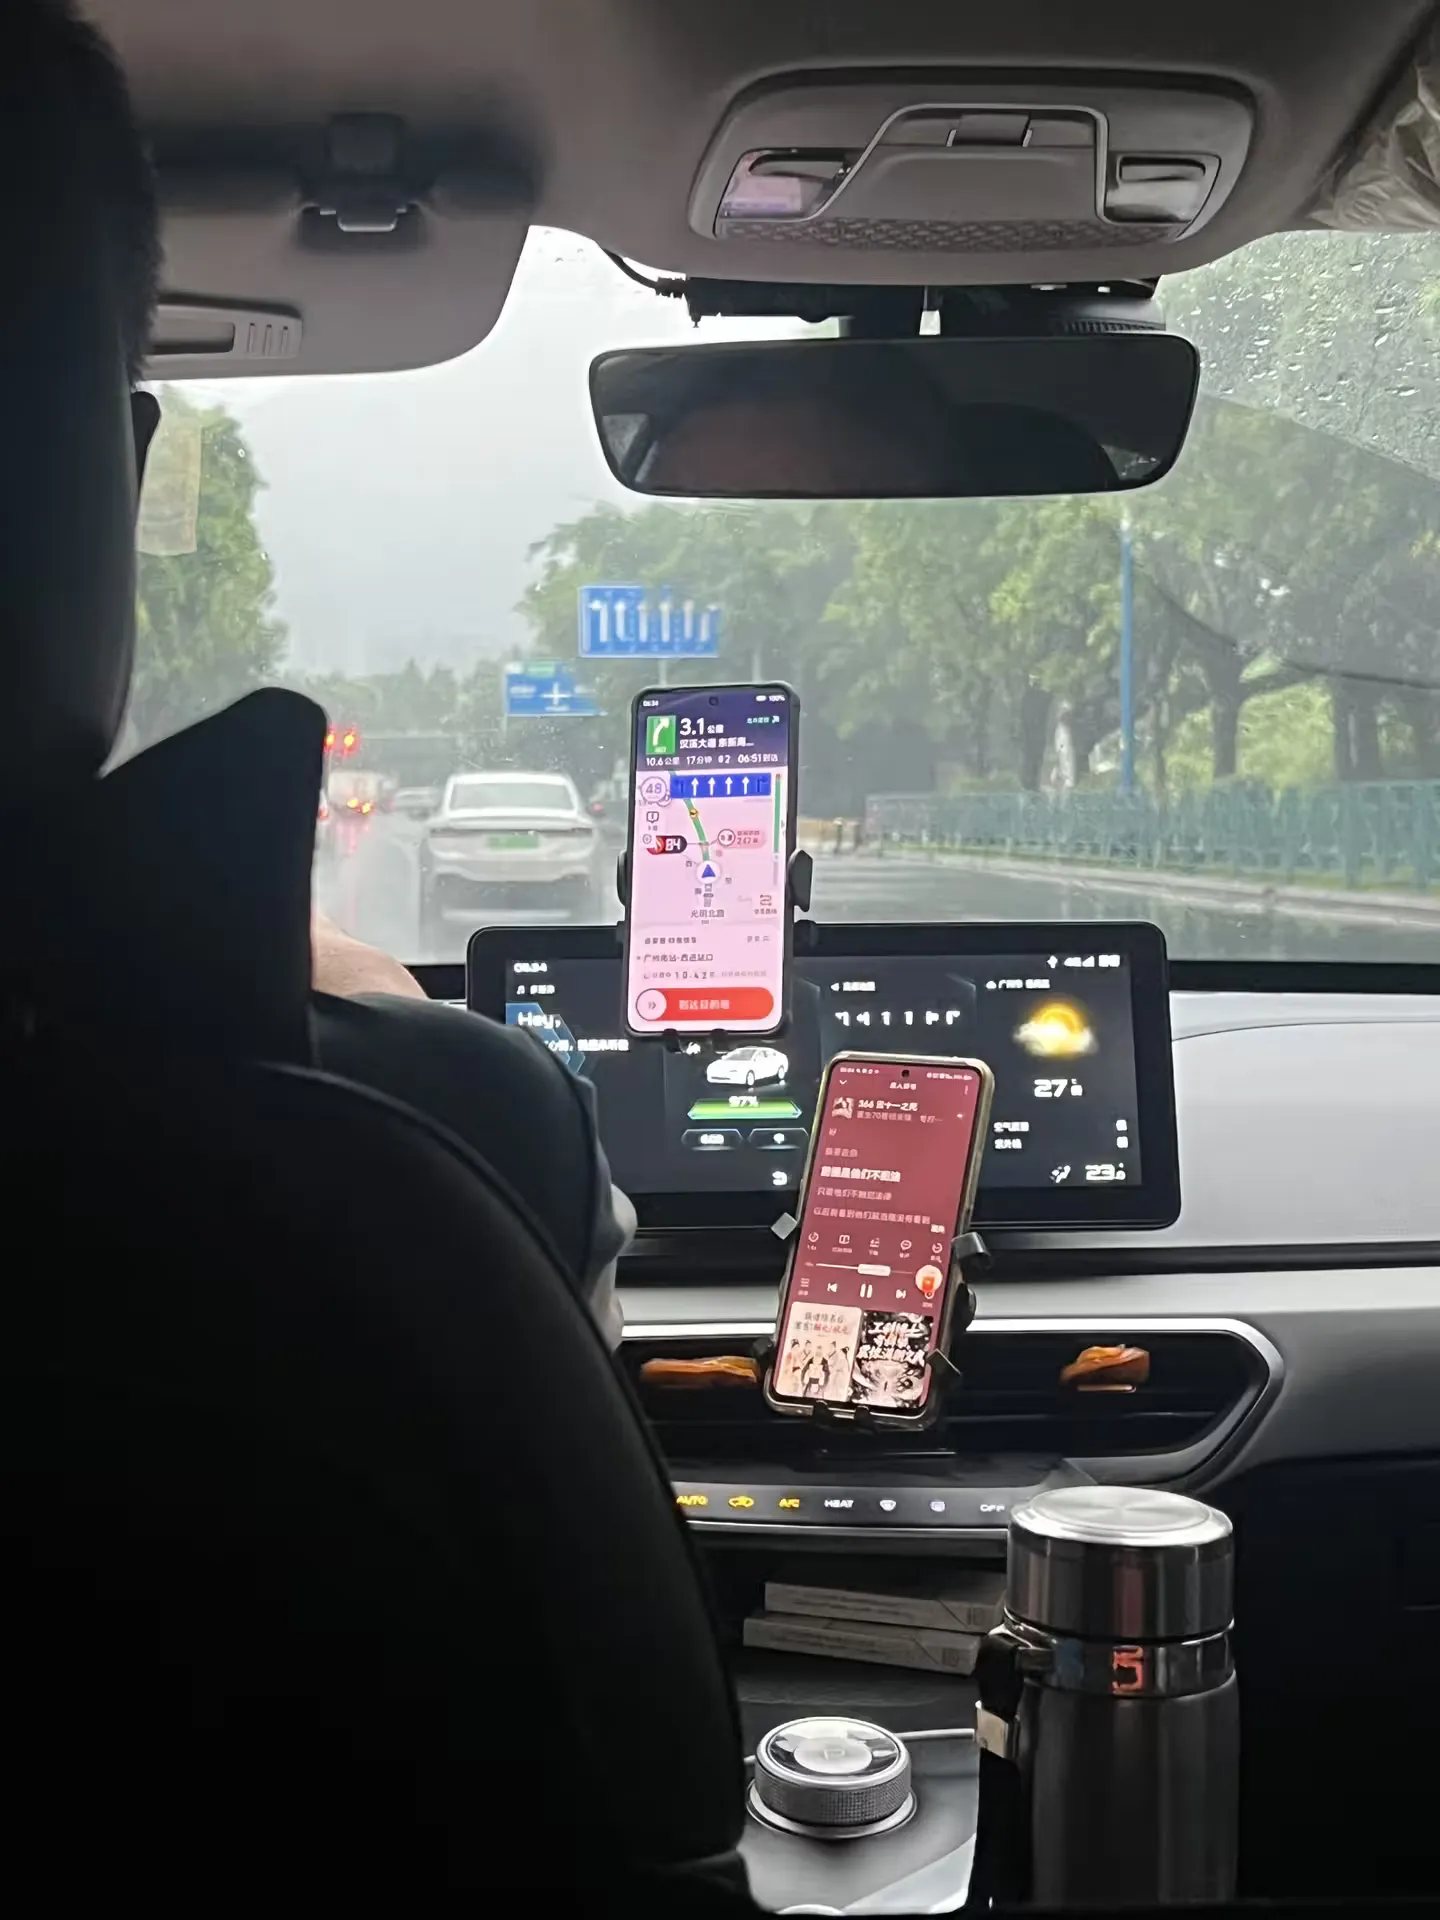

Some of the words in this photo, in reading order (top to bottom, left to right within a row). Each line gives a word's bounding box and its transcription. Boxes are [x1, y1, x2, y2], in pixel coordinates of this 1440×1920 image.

[1034, 1078, 1068, 1098] 27
[676, 1494, 708, 1506] AUTO
[779, 1498, 801, 1509] A/C
[824, 1499, 854, 1509] HEAT
[980, 1503, 1006, 1513] OFF
